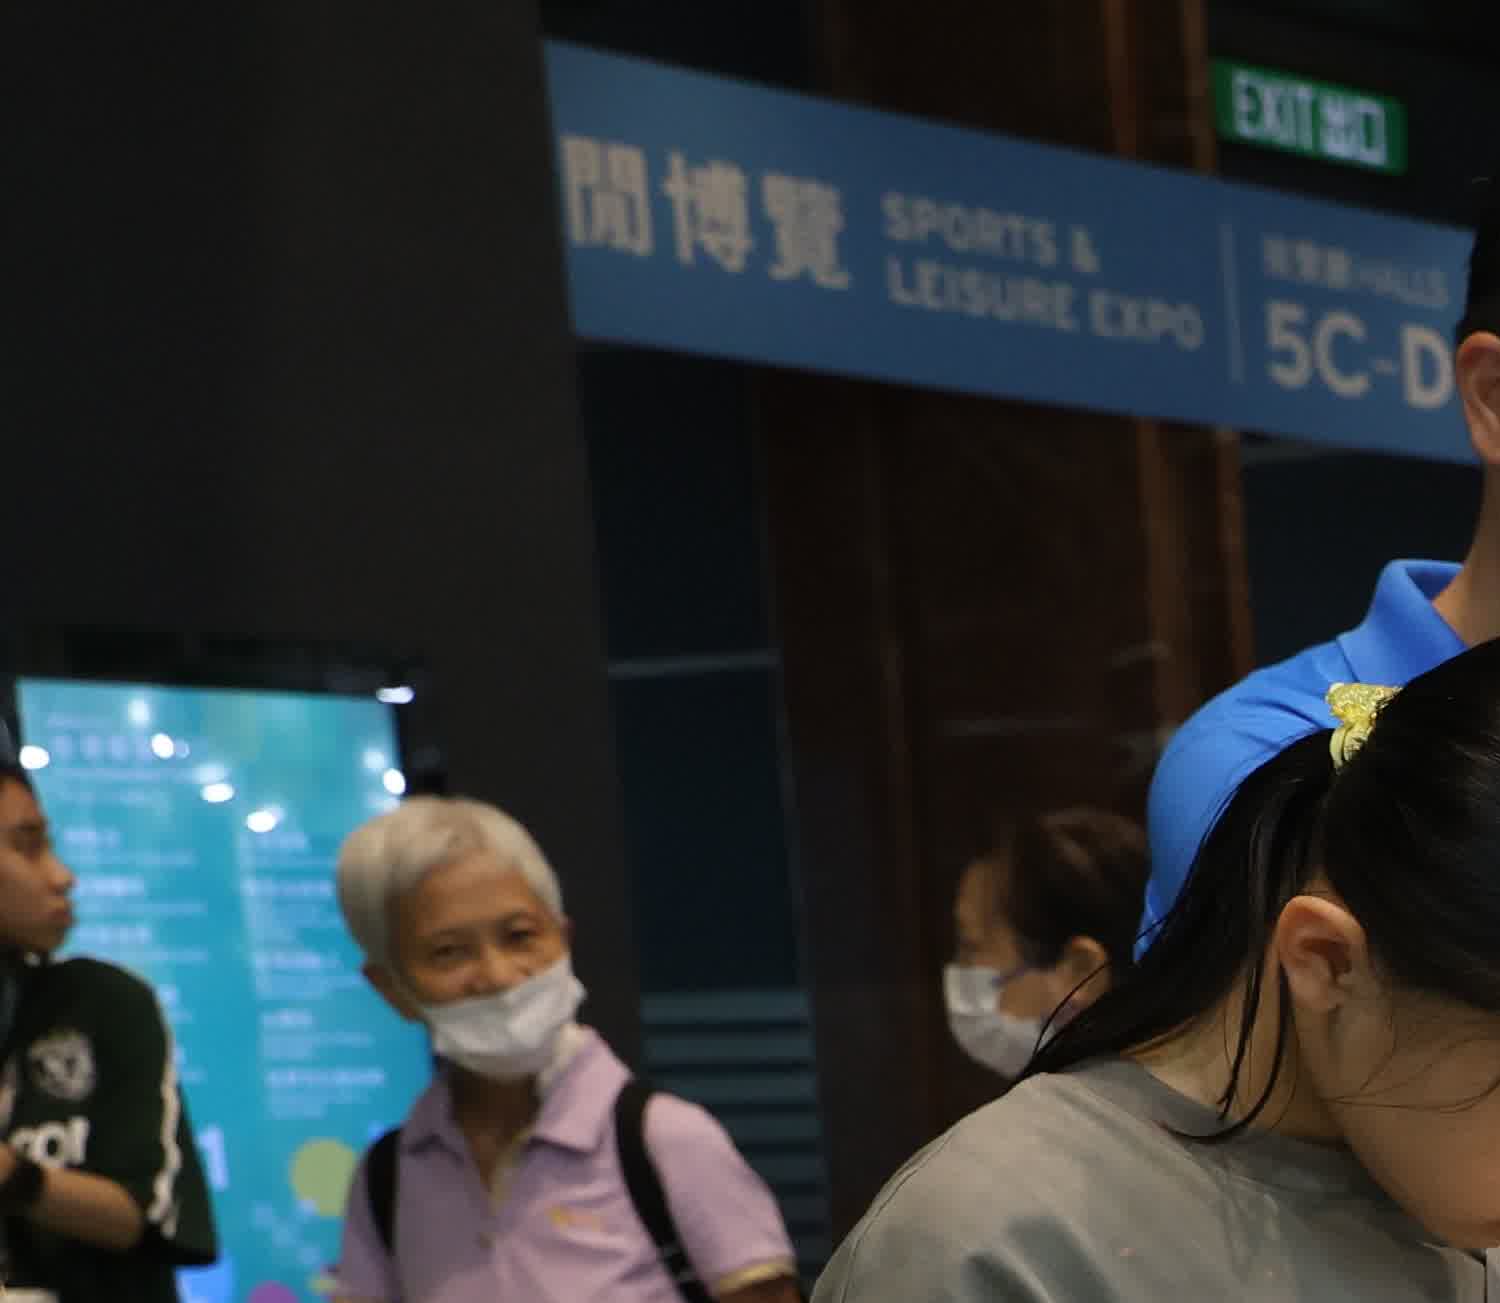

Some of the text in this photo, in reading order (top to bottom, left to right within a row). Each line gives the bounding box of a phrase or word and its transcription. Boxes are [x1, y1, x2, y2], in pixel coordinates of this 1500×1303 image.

[1232, 68, 1389, 166] EXIT 出口
[881, 190, 1100, 274] SPORTS &
[887, 257, 1203, 350] LEISURE EXPO
[1268, 301, 1453, 409] 5C-D
